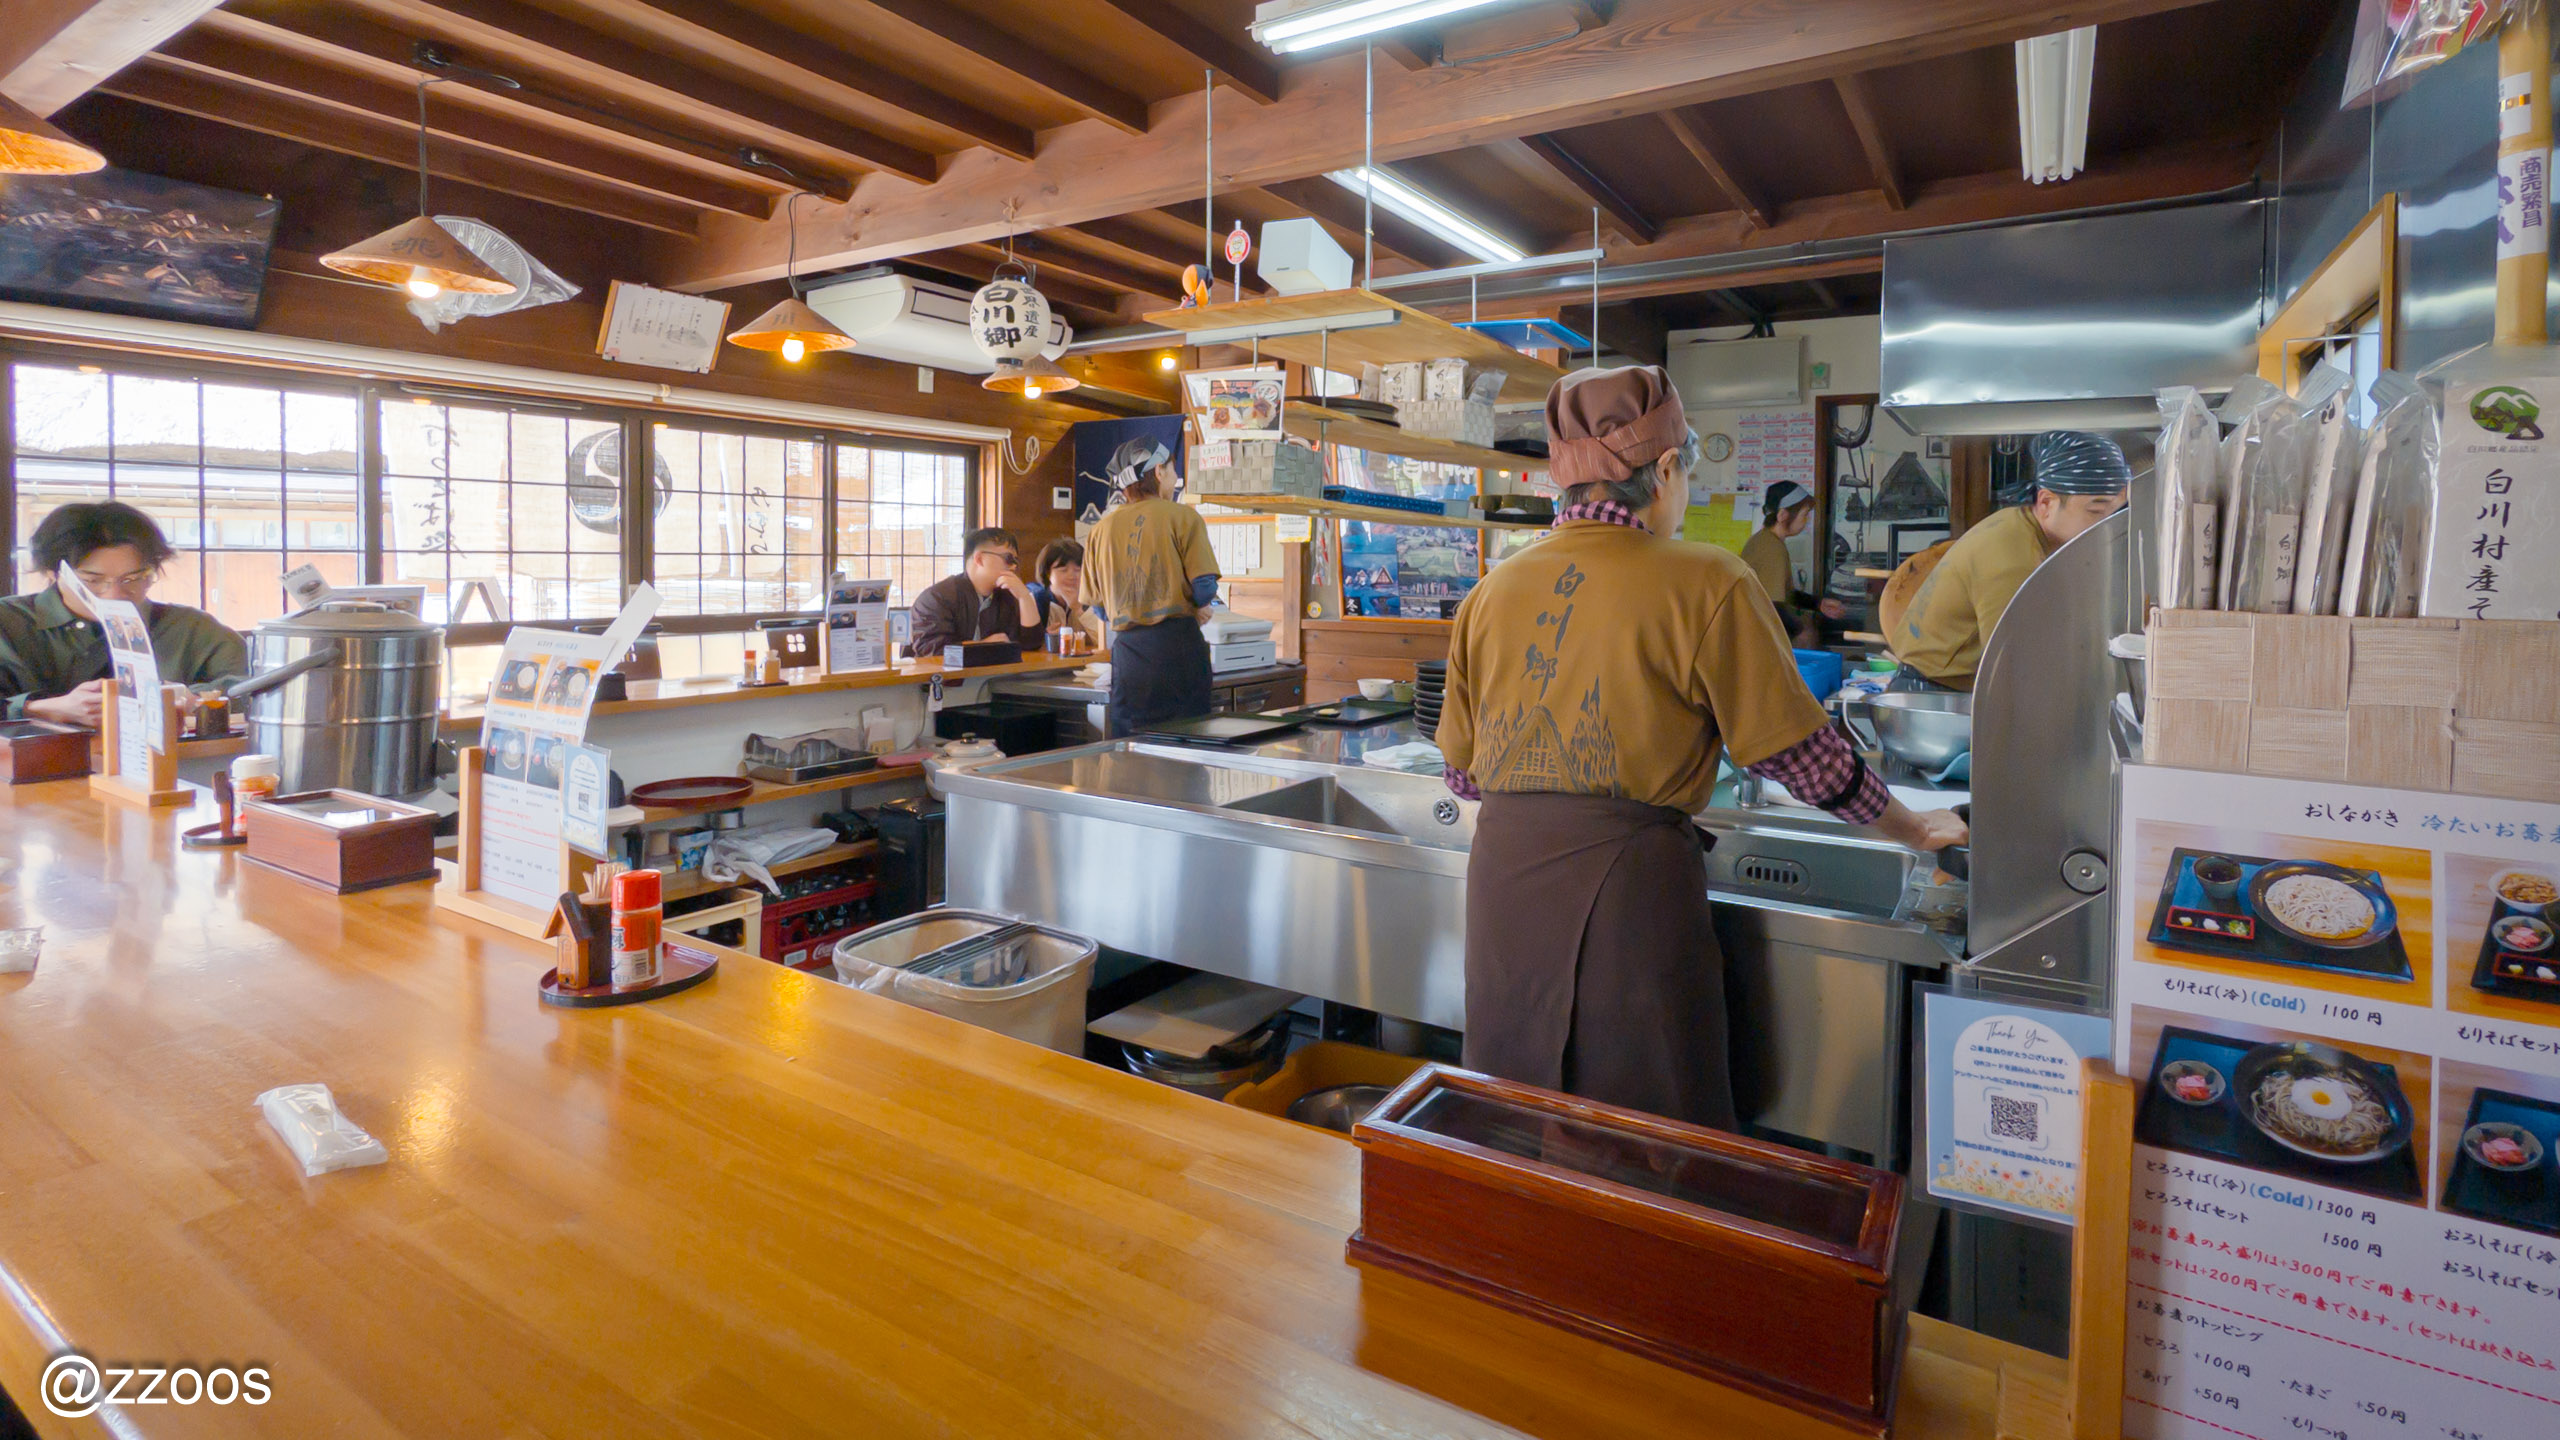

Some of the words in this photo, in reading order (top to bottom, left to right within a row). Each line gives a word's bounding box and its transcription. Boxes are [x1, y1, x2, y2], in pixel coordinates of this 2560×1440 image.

[982, 284, 1022, 348] 白川郷
[1020, 286, 1041, 339] 世界遺産
[2465, 467, 2513, 620] 白川村産そ
[1520, 562, 1585, 702] 白川郷
[2304, 802, 2399, 828] おしながき
[2251, 991, 2306, 1014] (Cold)
[1984, 1020, 2016, 1041] Thank
[2023, 1028, 2049, 1049] You
[2144, 1188, 2249, 1224] とろろそばセット
[2249, 1182, 2313, 1210] (Cold)
[2444, 1228, 2560, 1265] おろしそば(冷
[2136, 1299, 2264, 1342] お蕎麦のトッピング
